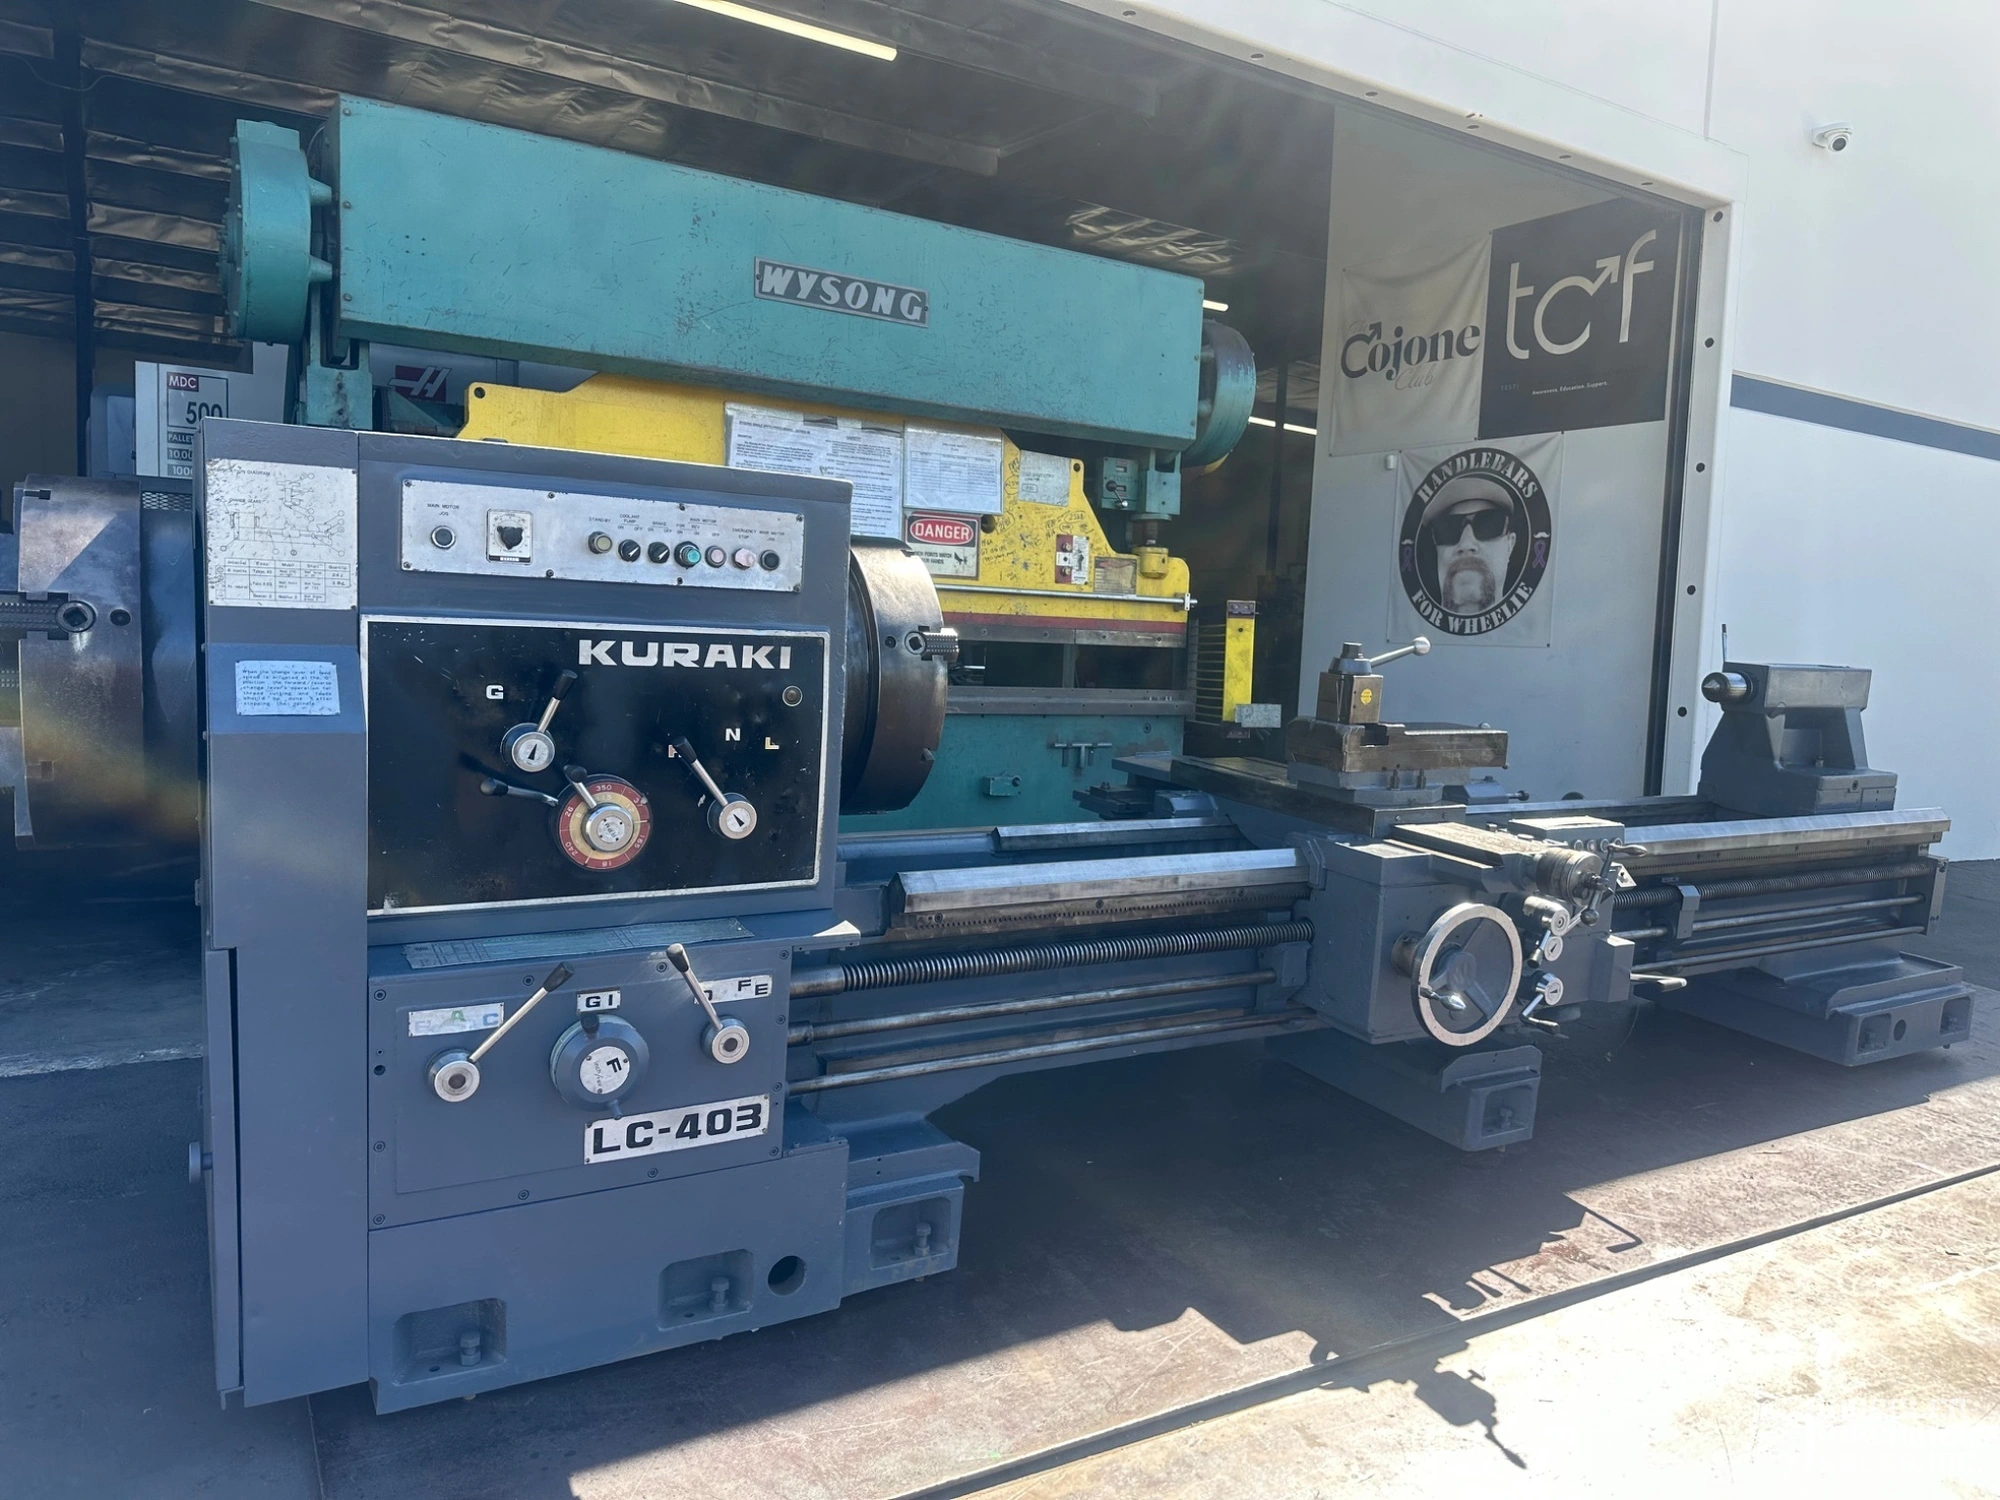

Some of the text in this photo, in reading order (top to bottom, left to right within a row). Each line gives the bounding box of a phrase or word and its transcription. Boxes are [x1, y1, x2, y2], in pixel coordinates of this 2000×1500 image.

[761, 264, 922, 321] WYSONG
[1341, 321, 1481, 381] Cojone
[168, 375, 197, 388] MDC
[1394, 362, 1436, 391] Club
[185, 401, 223, 424] 500
[168, 432, 193, 442] PALLE
[1416, 451, 1538, 504] HANDLEBARS
[732, 527, 757, 535] EMERGENCY
[915, 522, 970, 540] DANGER
[1411, 589, 1444, 627] FOR
[1448, 581, 1533, 634] WHEELIE
[578, 639, 792, 670] KURAKI
[485, 684, 504, 700] G
[725, 727, 741, 742] N
[764, 736, 780, 751] L
[595, 783, 613, 792] 350
[564, 806, 574, 818] 26
[564, 840, 579, 857] 240
[601, 860, 613, 868] 18
[738, 979, 751, 992] F
[755, 983, 768, 996] E
[451, 1010, 467, 1022] A
[482, 1012, 499, 1027] C
[606, 1057, 623, 1073] F
[593, 1102, 762, 1154] LC-403
